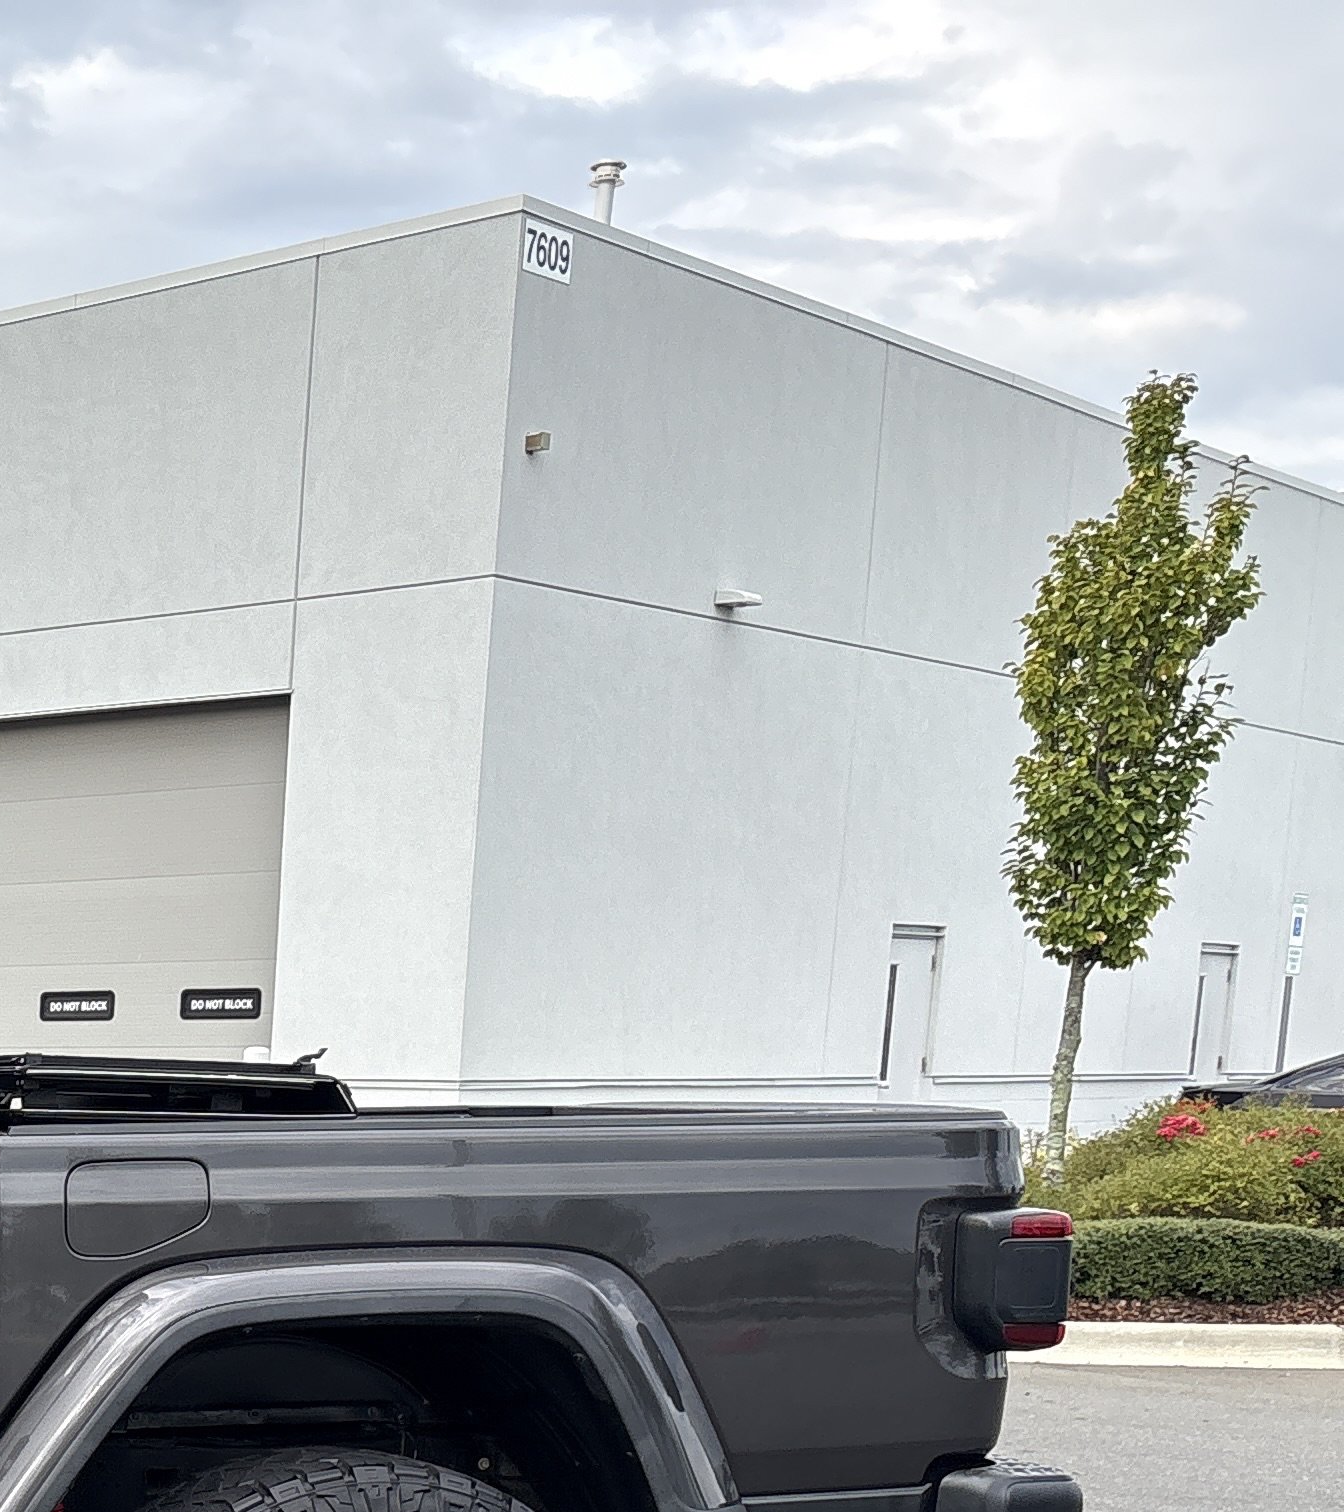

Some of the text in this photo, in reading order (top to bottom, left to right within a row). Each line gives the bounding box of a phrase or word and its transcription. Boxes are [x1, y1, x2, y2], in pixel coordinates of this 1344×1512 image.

[527, 227, 571, 275] 7609
[49, 1000, 108, 1012] DO NOT BLOCK
[191, 998, 253, 1010] DO NOT BLOCK
